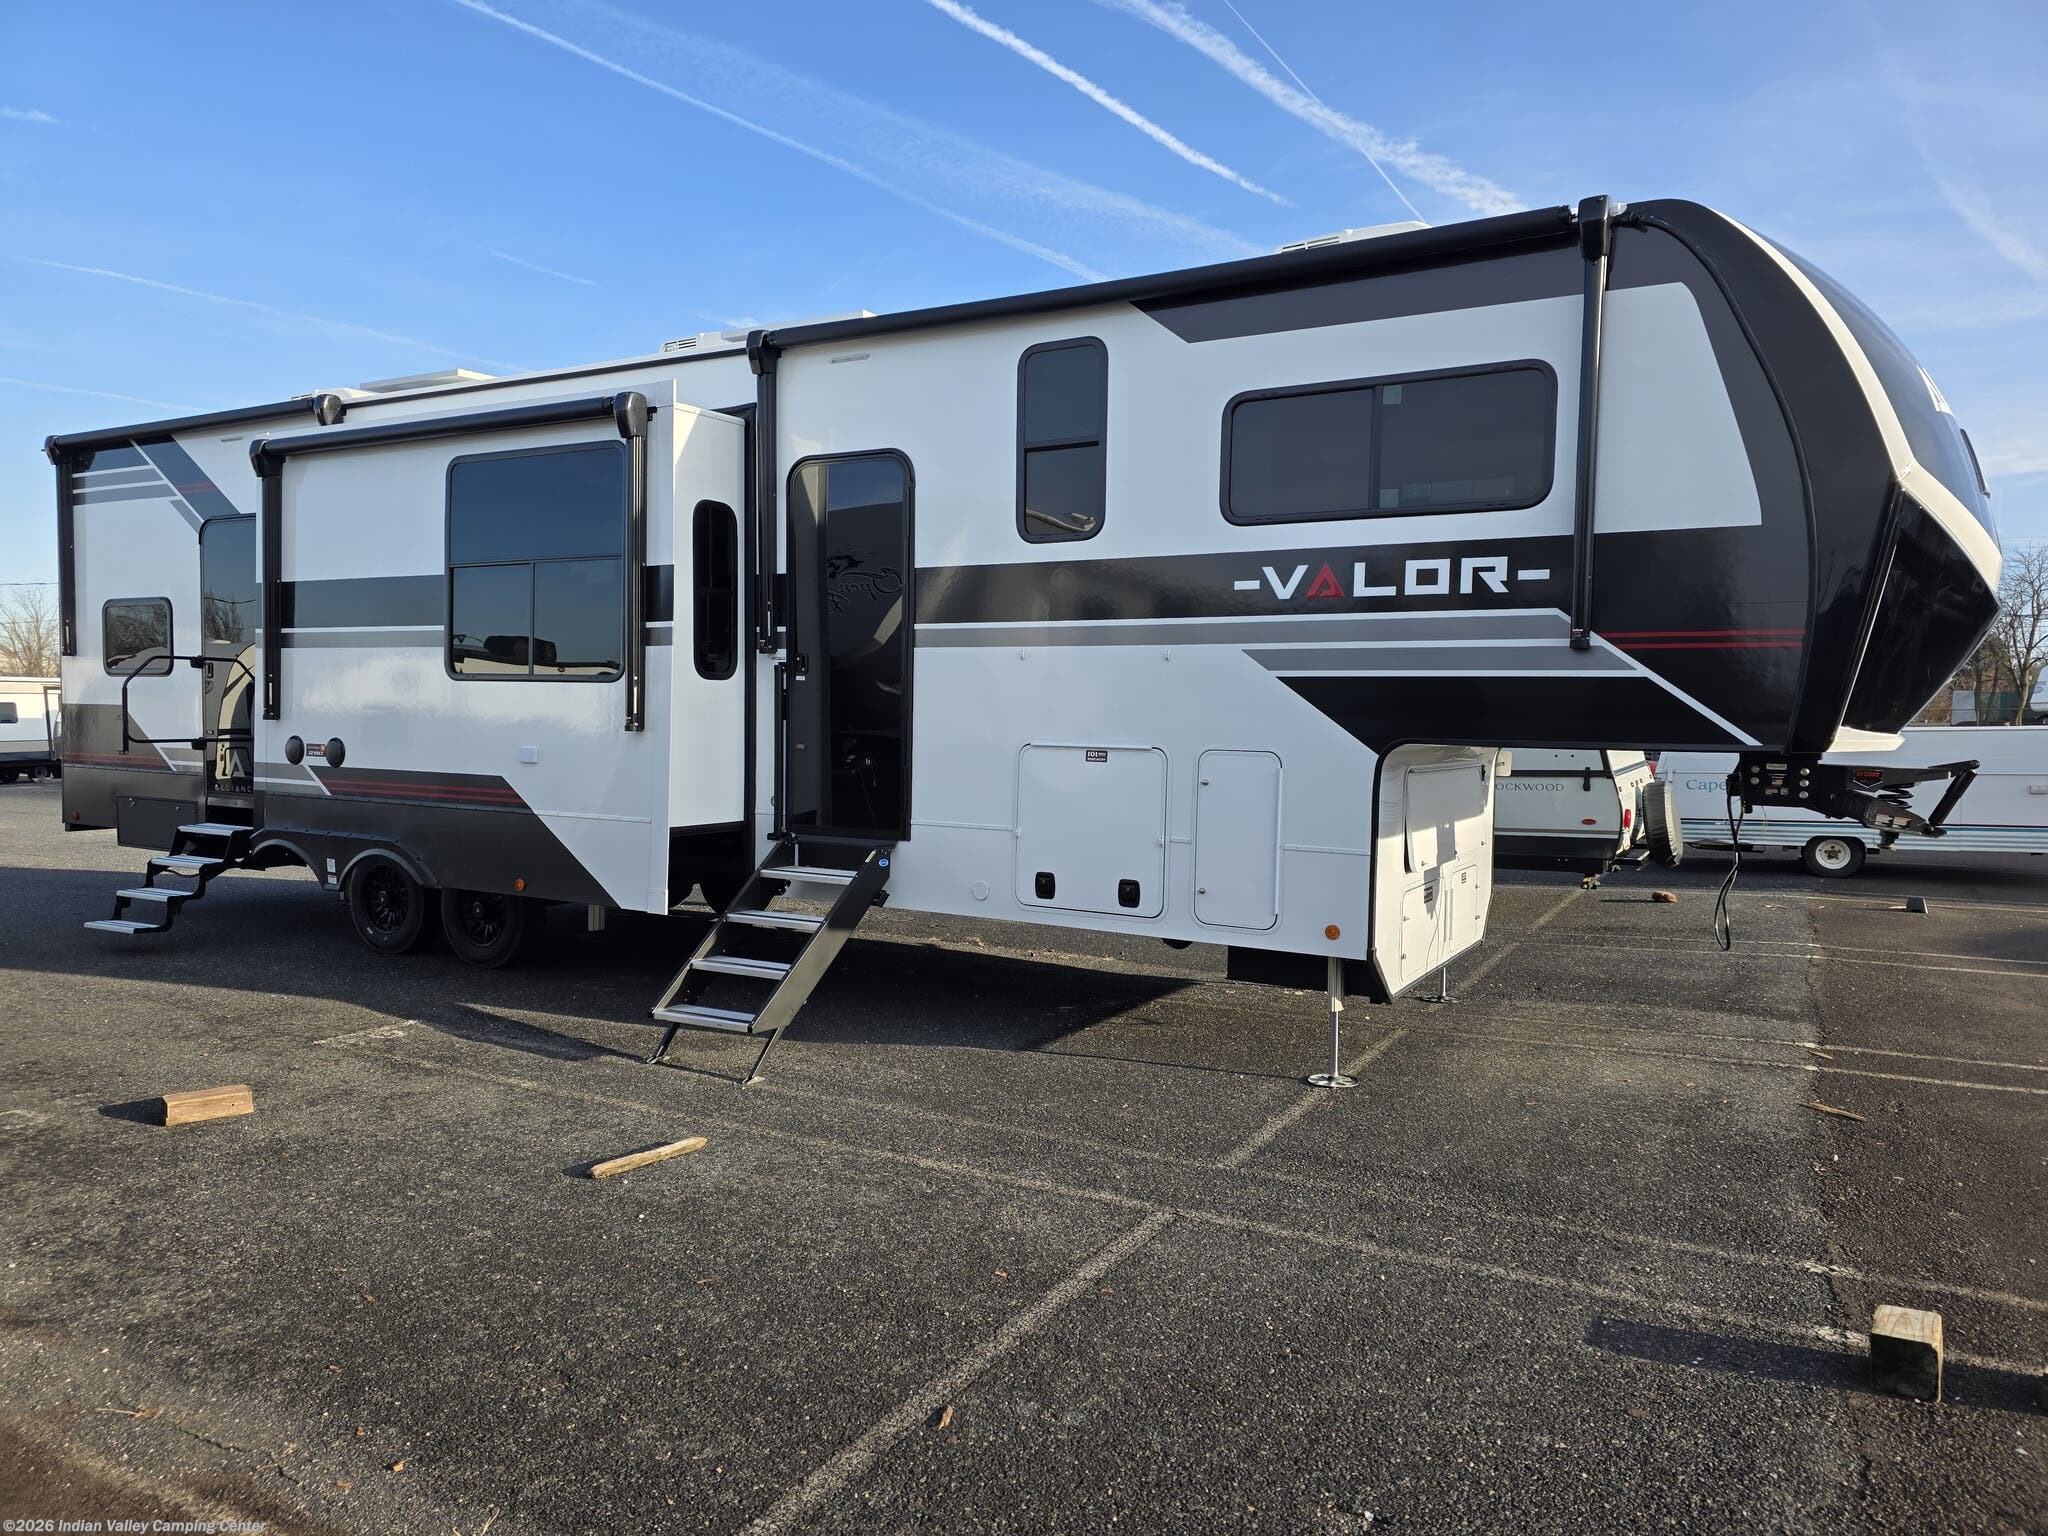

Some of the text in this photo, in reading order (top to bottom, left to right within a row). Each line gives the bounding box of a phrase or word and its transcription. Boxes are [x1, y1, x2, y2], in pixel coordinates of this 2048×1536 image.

[214, 783, 252, 793] ALLIANC
[1495, 782, 1565, 792] OCKWOOD
[1686, 779, 1727, 793] Cape
